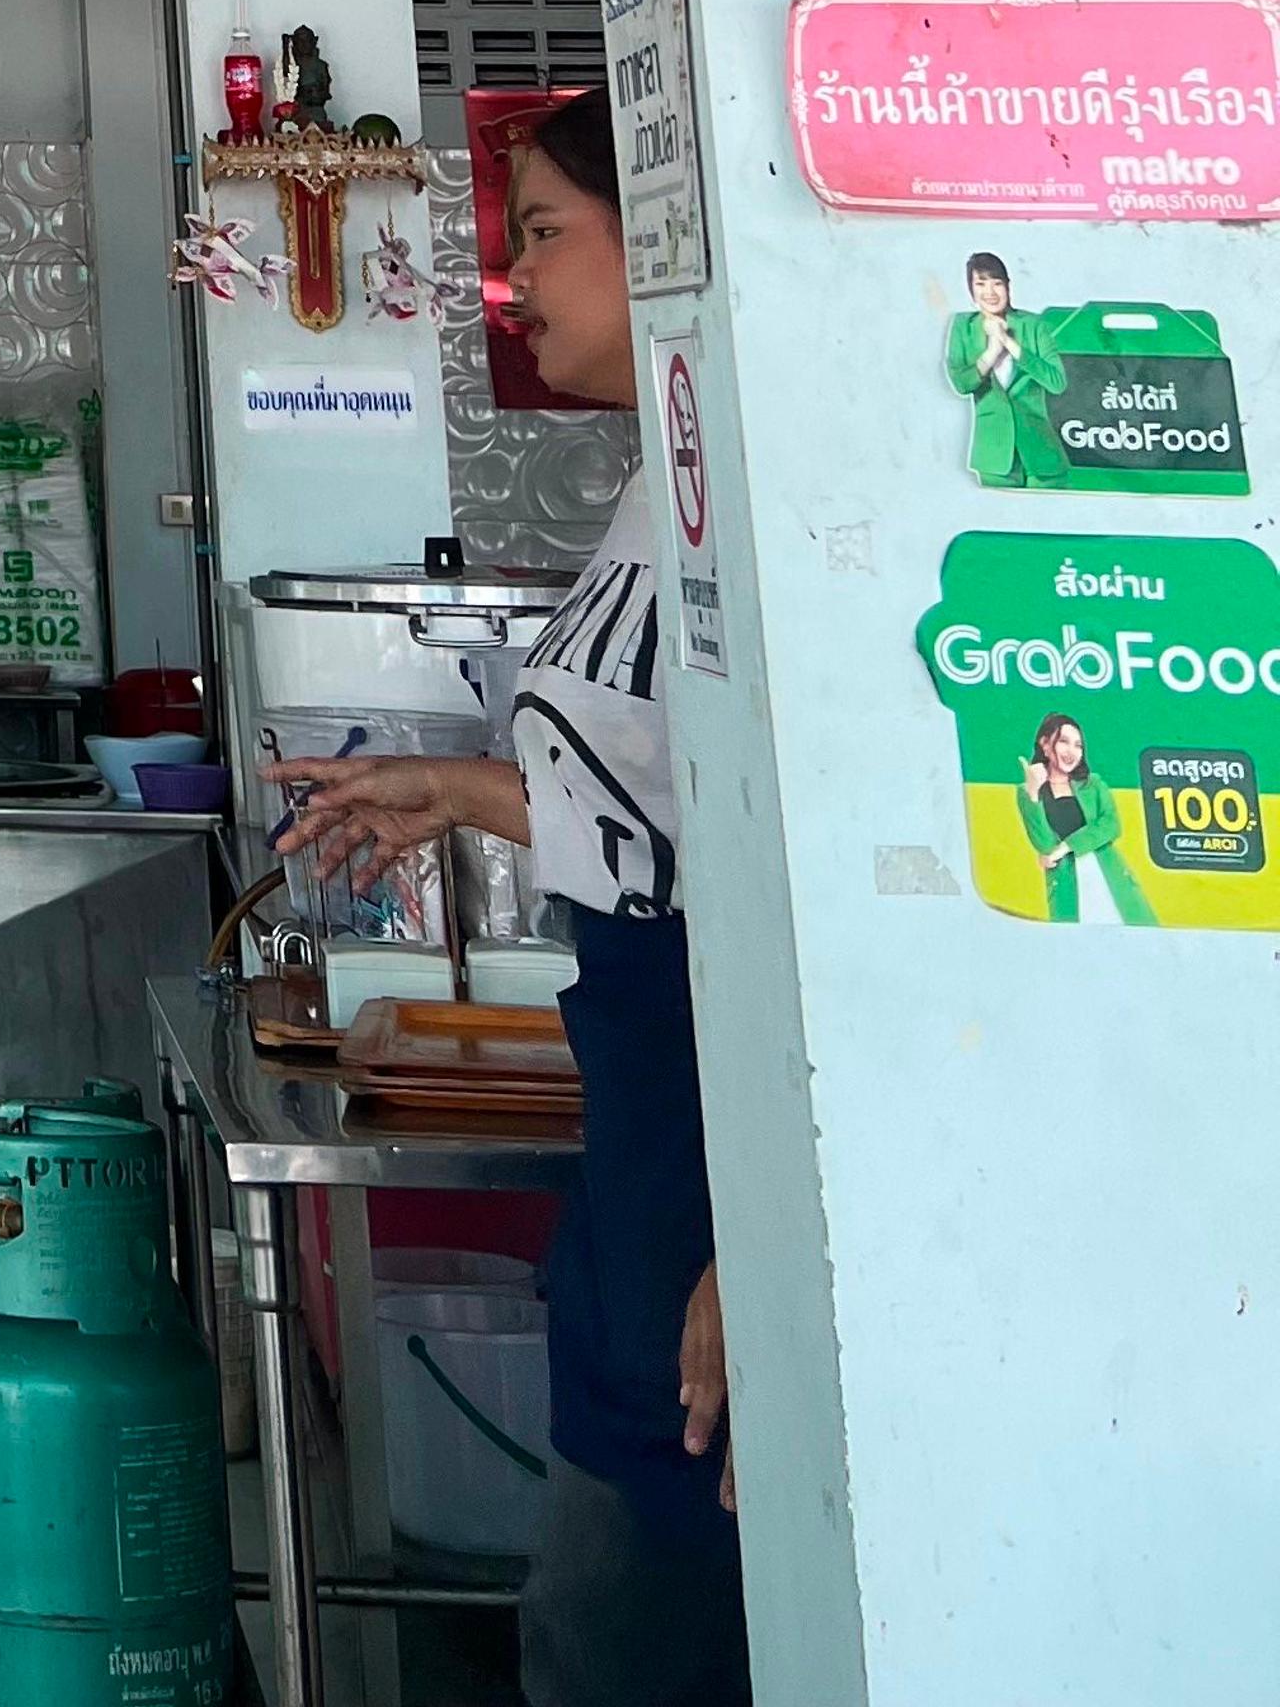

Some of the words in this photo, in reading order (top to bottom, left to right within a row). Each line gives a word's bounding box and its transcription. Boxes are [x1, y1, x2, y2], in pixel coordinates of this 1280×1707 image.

[1101, 148, 1240, 186] makro
[247, 375, 412, 420] ขอบคุณที่มาอุดหนุน
[1060, 420, 1231, 453] GrabFood
[1054, 558, 1167, 600] สั่งผ่าน
[1152, 759, 1245, 785] ลดสูงสุด
[1154, 787, 1248, 833] 100
